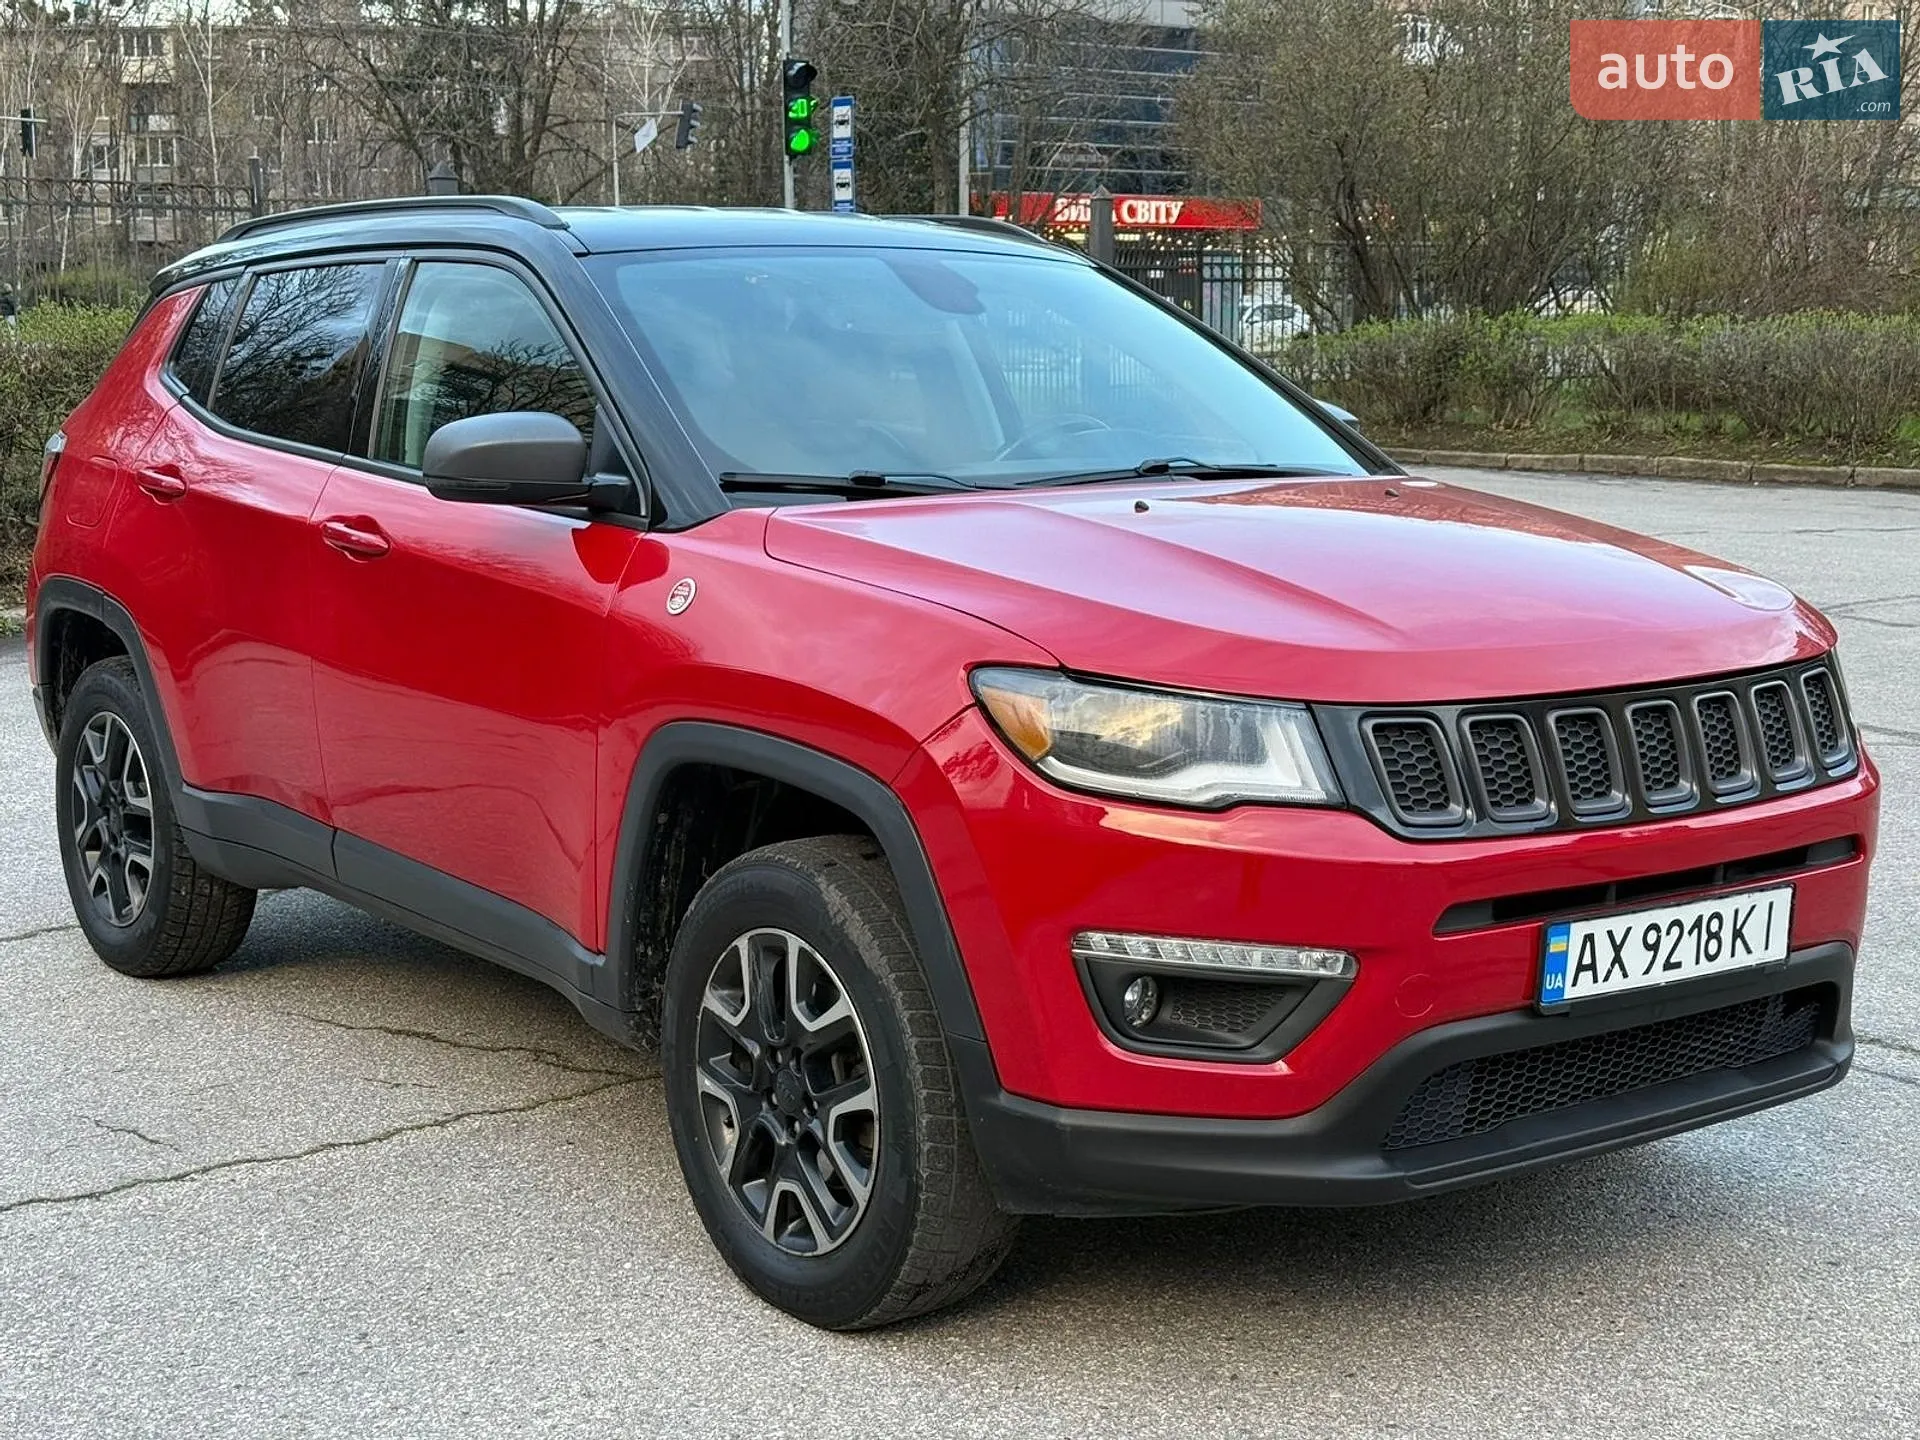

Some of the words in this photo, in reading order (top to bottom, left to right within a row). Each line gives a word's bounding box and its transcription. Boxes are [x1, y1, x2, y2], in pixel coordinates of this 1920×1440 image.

[1121, 199, 1184, 224] СВІТУ
[1571, 925, 1633, 988] AX
[1641, 911, 1724, 976] 9218
[1730, 900, 1774, 959] KI
[1545, 972, 1563, 990] UA
